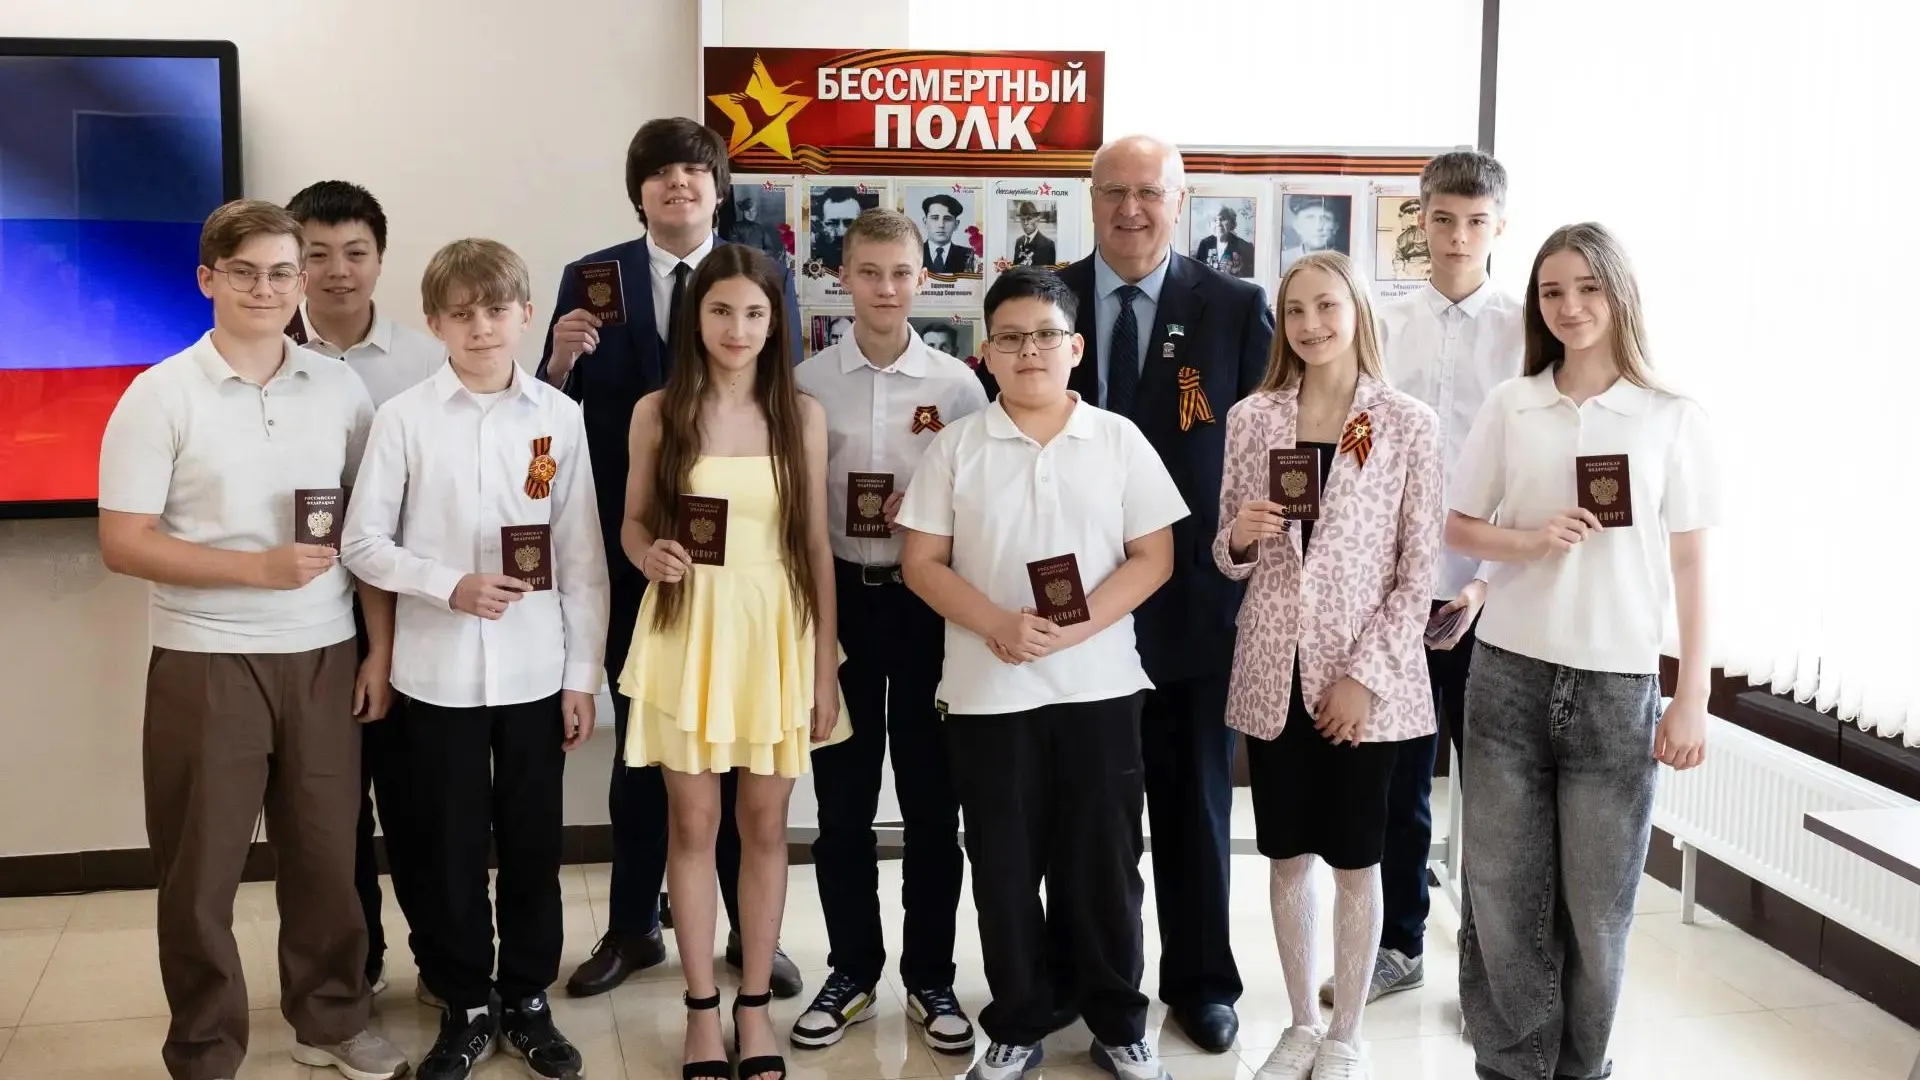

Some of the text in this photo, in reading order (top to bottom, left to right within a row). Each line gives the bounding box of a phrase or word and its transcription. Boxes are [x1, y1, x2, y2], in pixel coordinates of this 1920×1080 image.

[817, 61, 1087, 103] БЕССМЕРТНЫЙ
[874, 104, 1037, 150] ПОЛК
[852, 523, 885, 532] ПАСПОРТ
